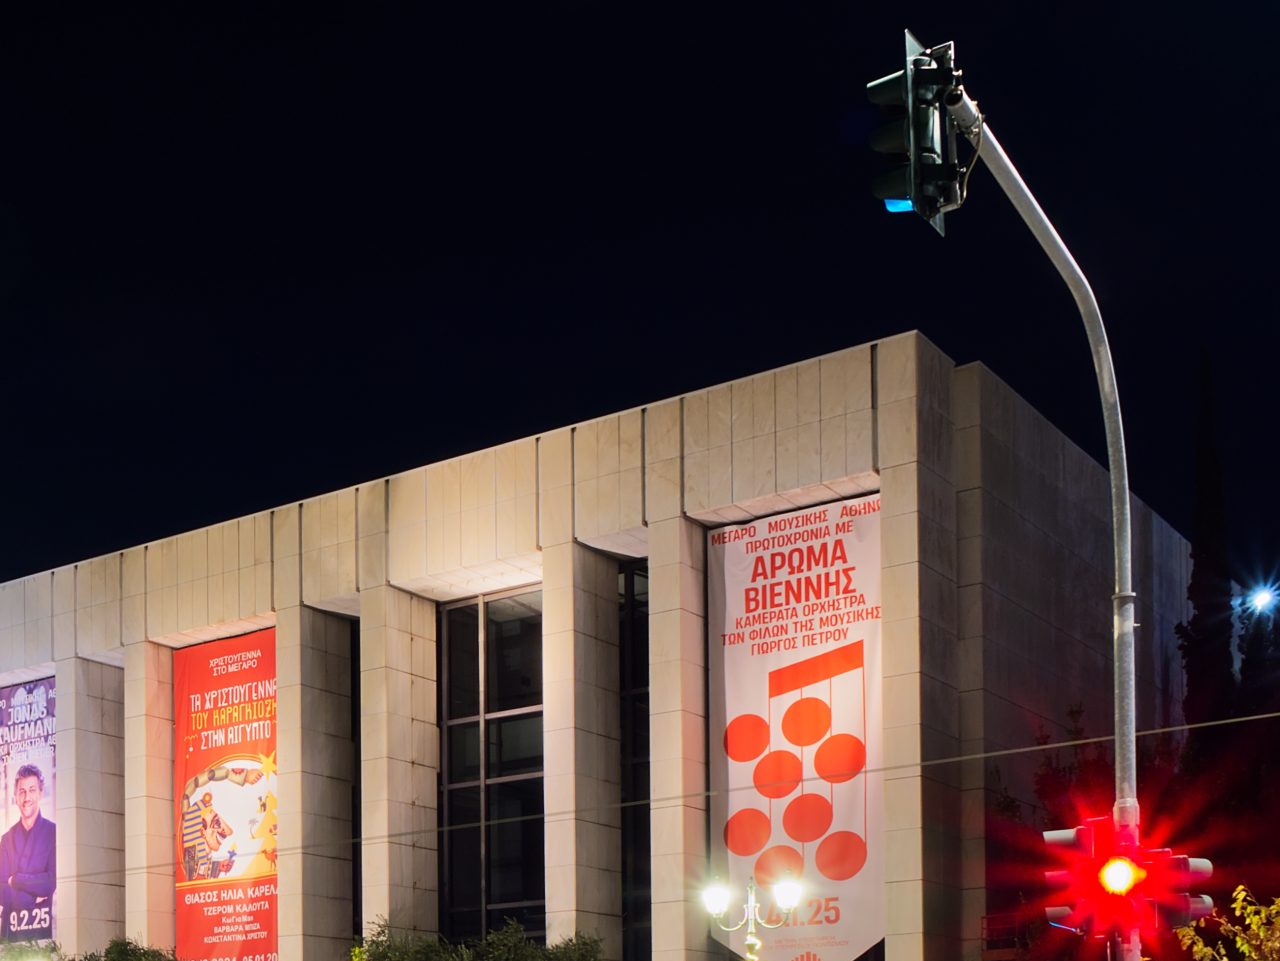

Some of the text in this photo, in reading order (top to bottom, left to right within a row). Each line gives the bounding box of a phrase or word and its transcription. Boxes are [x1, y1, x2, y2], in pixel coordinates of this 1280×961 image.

[711, 526, 756, 546] ΜΕΓΑΡΟ
[768, 510, 829, 534] ΜΟΥΣΙΚΗΣ
[746, 520, 853, 554] ΠΡΩΤΟΧΡΟΝΙΑ ΜΕ
[751, 538, 848, 583] ΑΡΩΜΑ
[745, 566, 857, 614] ΒΙΕΝΝΗΣ
[735, 593, 866, 629] ΚΑΜΕΡΑΤΑ ΟΡΧΗΣΤΡΑ
[721, 606, 881, 647] ΤΩΝ ΦΙΛΩΝ ΤΗΣ ΜΟΥΣΙΚΗΣ
[751, 627, 849, 656] ΓΙΩΡΓΟΣ ΠΕΤΡΟΥ
[209, 649, 262, 668] ΧΡΙΣΤΟΥΓΕΝΝΑ
[213, 659, 258, 676] ΣΤΟ ΜΕΓΑΡΟ
[8, 701, 47, 725] JONAS
[190, 694, 201, 712] ΤΑ
[191, 711, 208, 730] ΤΟΥ
[201, 720, 271, 750] ΣΤΗΝ ΑΙΓΥΠΤΟ
[185, 890, 218, 904] ΘΙΑΣΟΣ
[221, 888, 244, 901] ΗΛΙΑ
[203, 901, 269, 916] ΤΖΕΡΟΜ ΚΑΛΟΥΤΑ
[10, 908, 50, 932] 9.2.25
